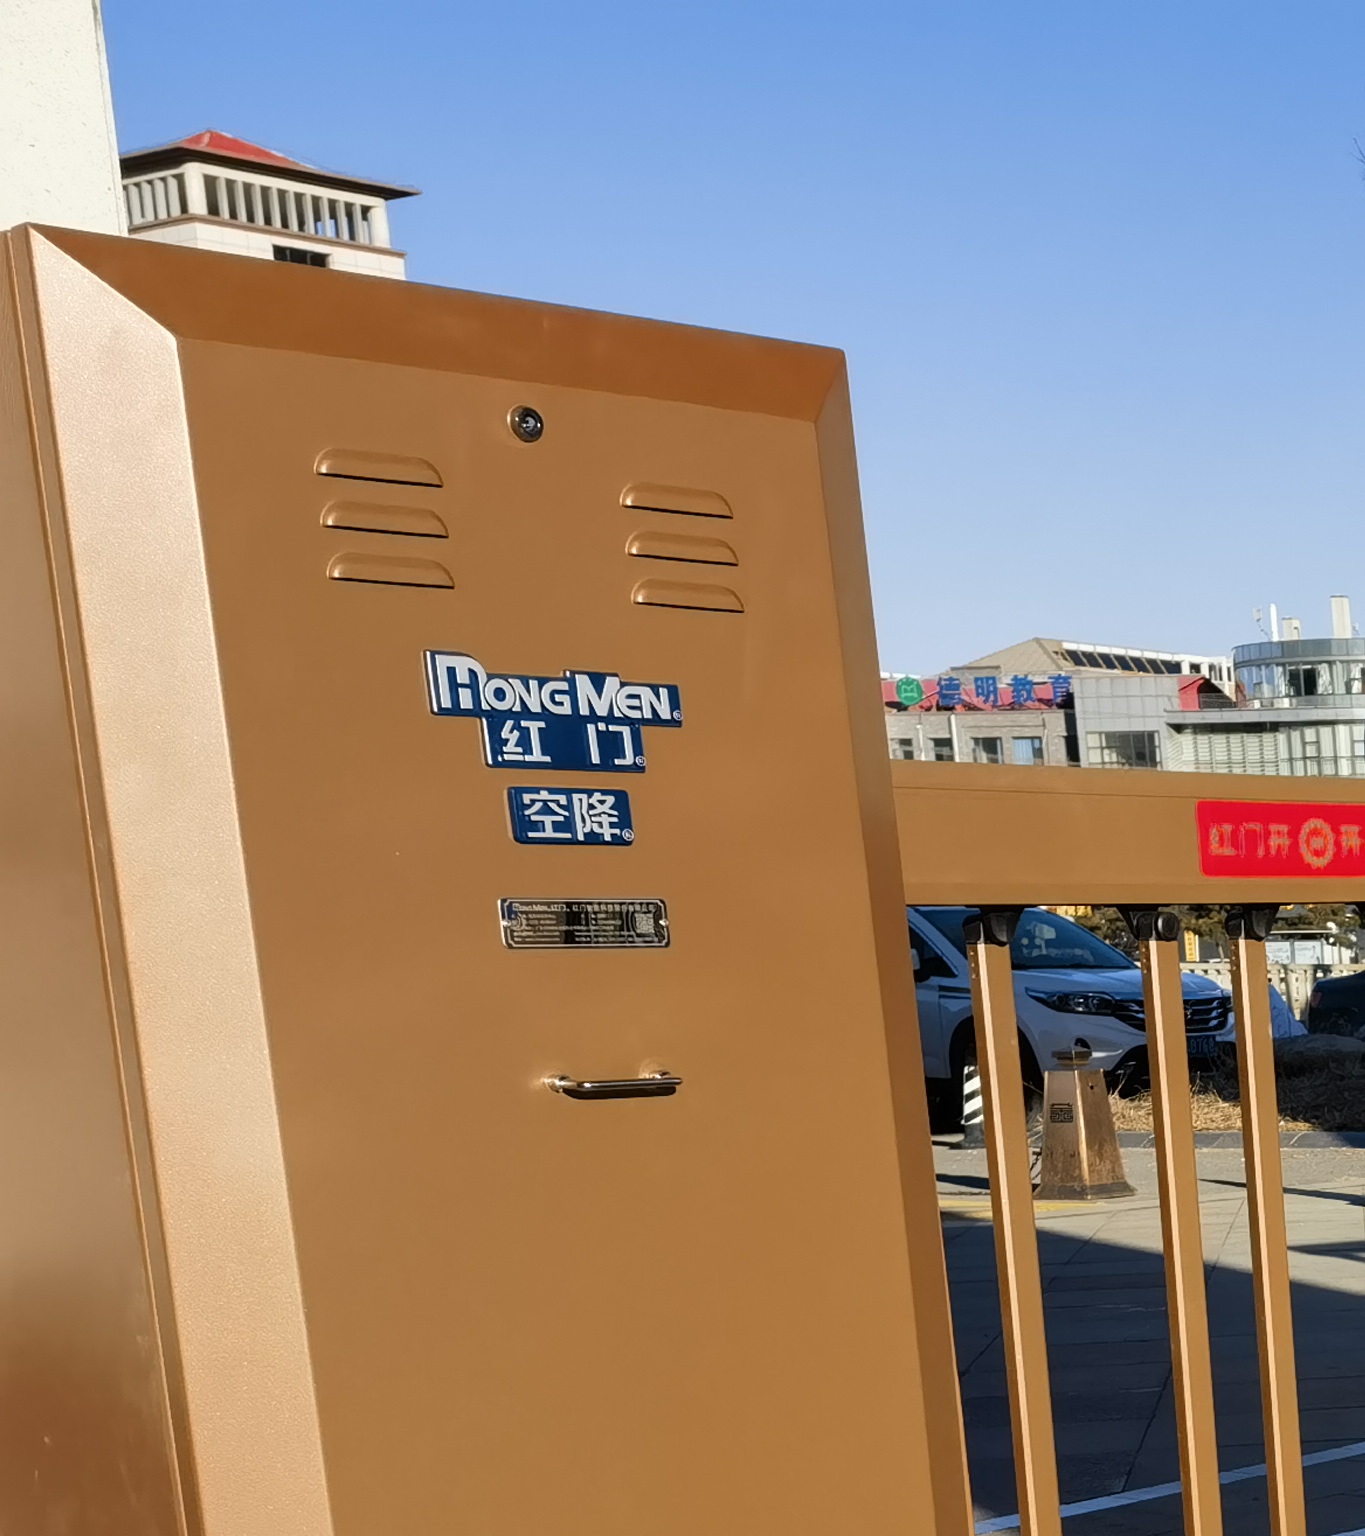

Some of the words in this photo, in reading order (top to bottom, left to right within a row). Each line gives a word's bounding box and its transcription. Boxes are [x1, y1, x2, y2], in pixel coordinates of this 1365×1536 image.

[498, 719, 634, 766] 红门
[522, 789, 622, 842] 空降
[1209, 822, 1293, 858] 红门开
